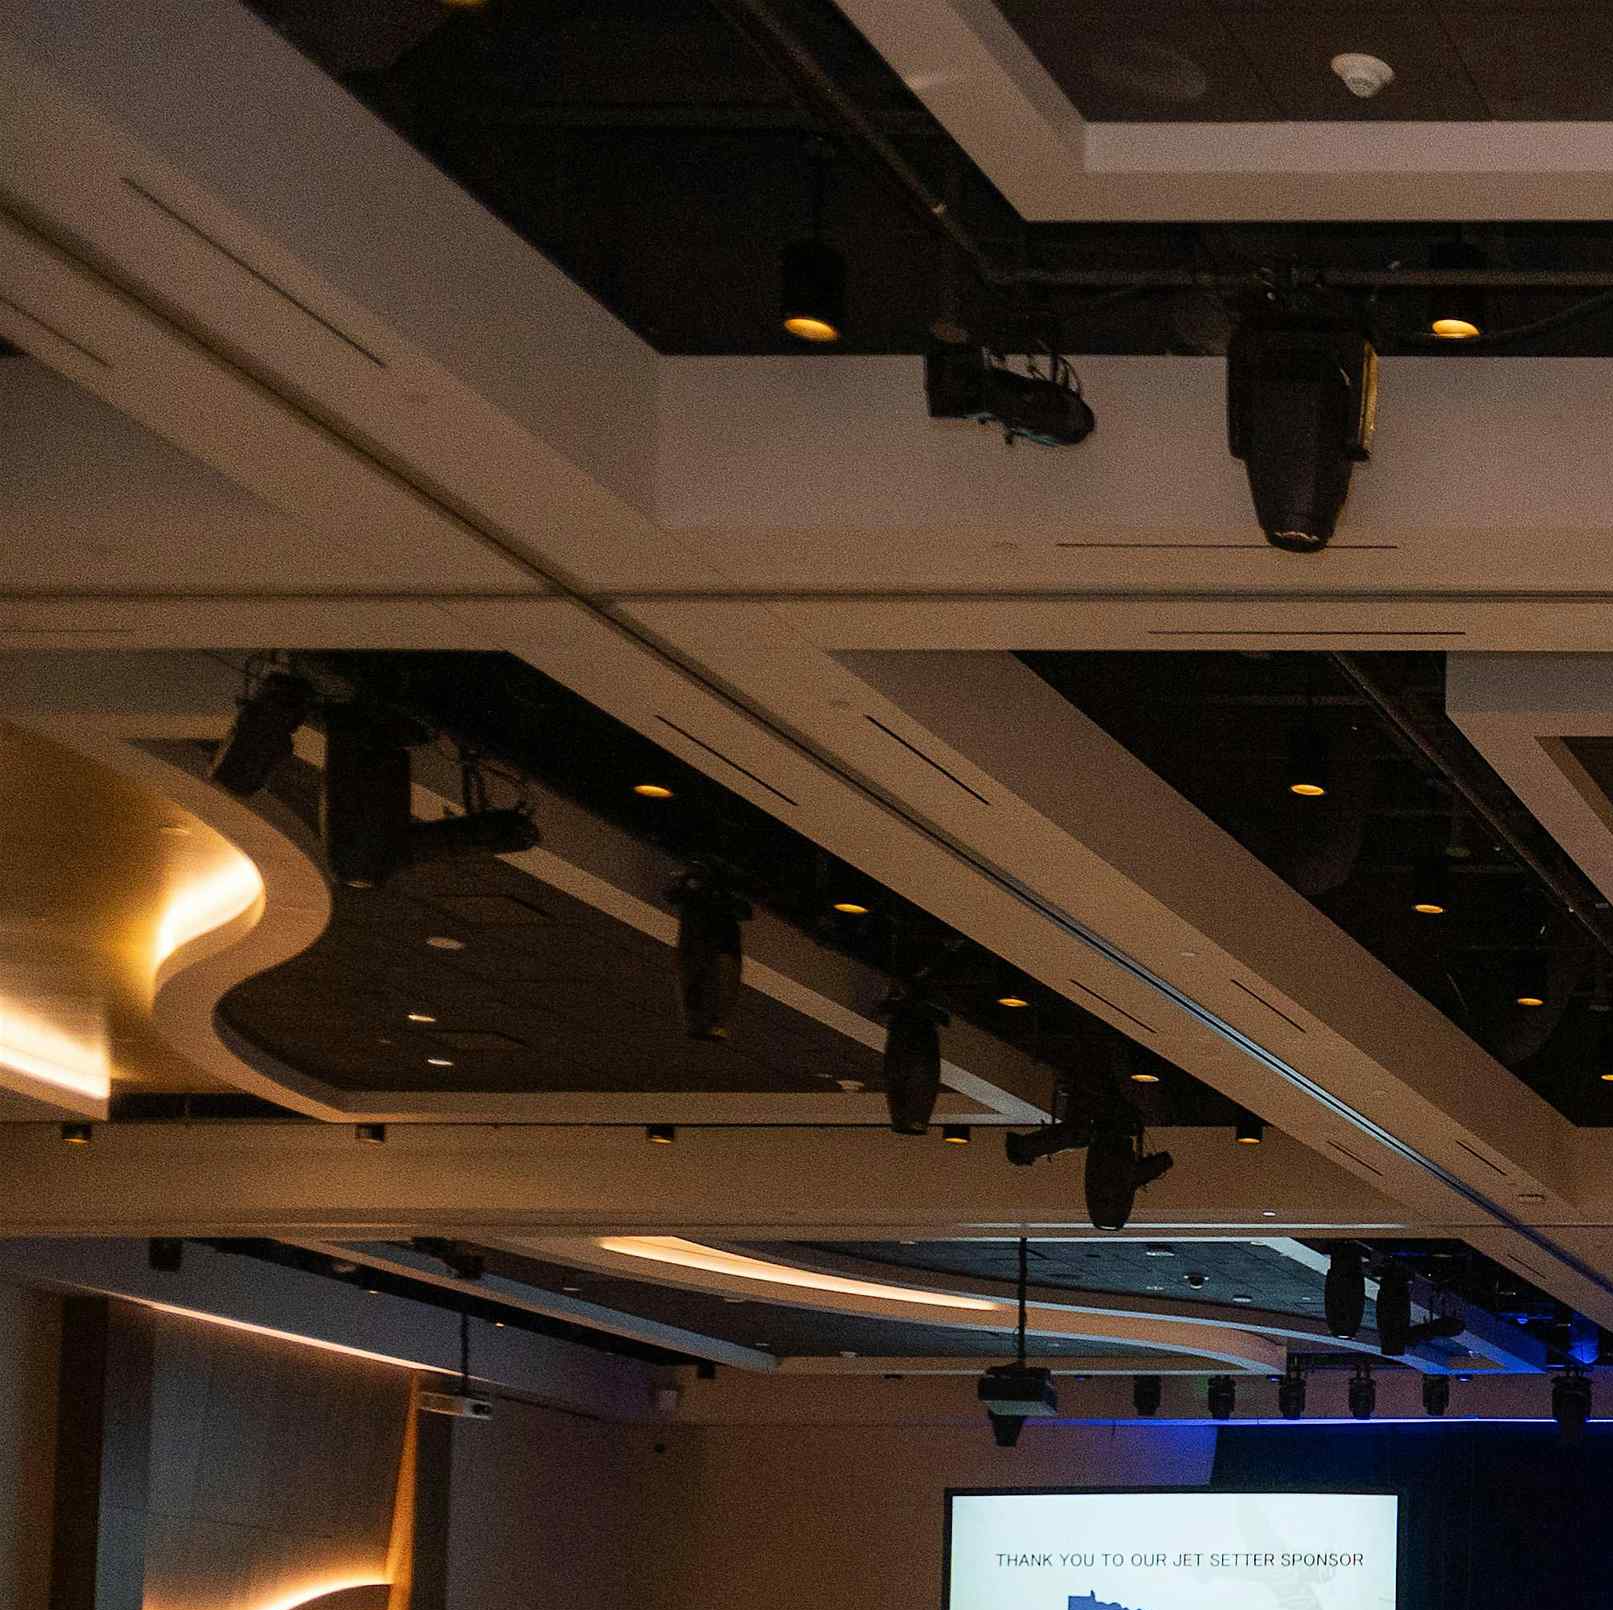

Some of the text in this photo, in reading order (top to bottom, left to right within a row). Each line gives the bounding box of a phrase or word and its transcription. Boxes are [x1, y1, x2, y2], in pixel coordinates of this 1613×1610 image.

[995, 1553, 1364, 1567] THANK YOU TO OUR JET SETTER SPONSOR
